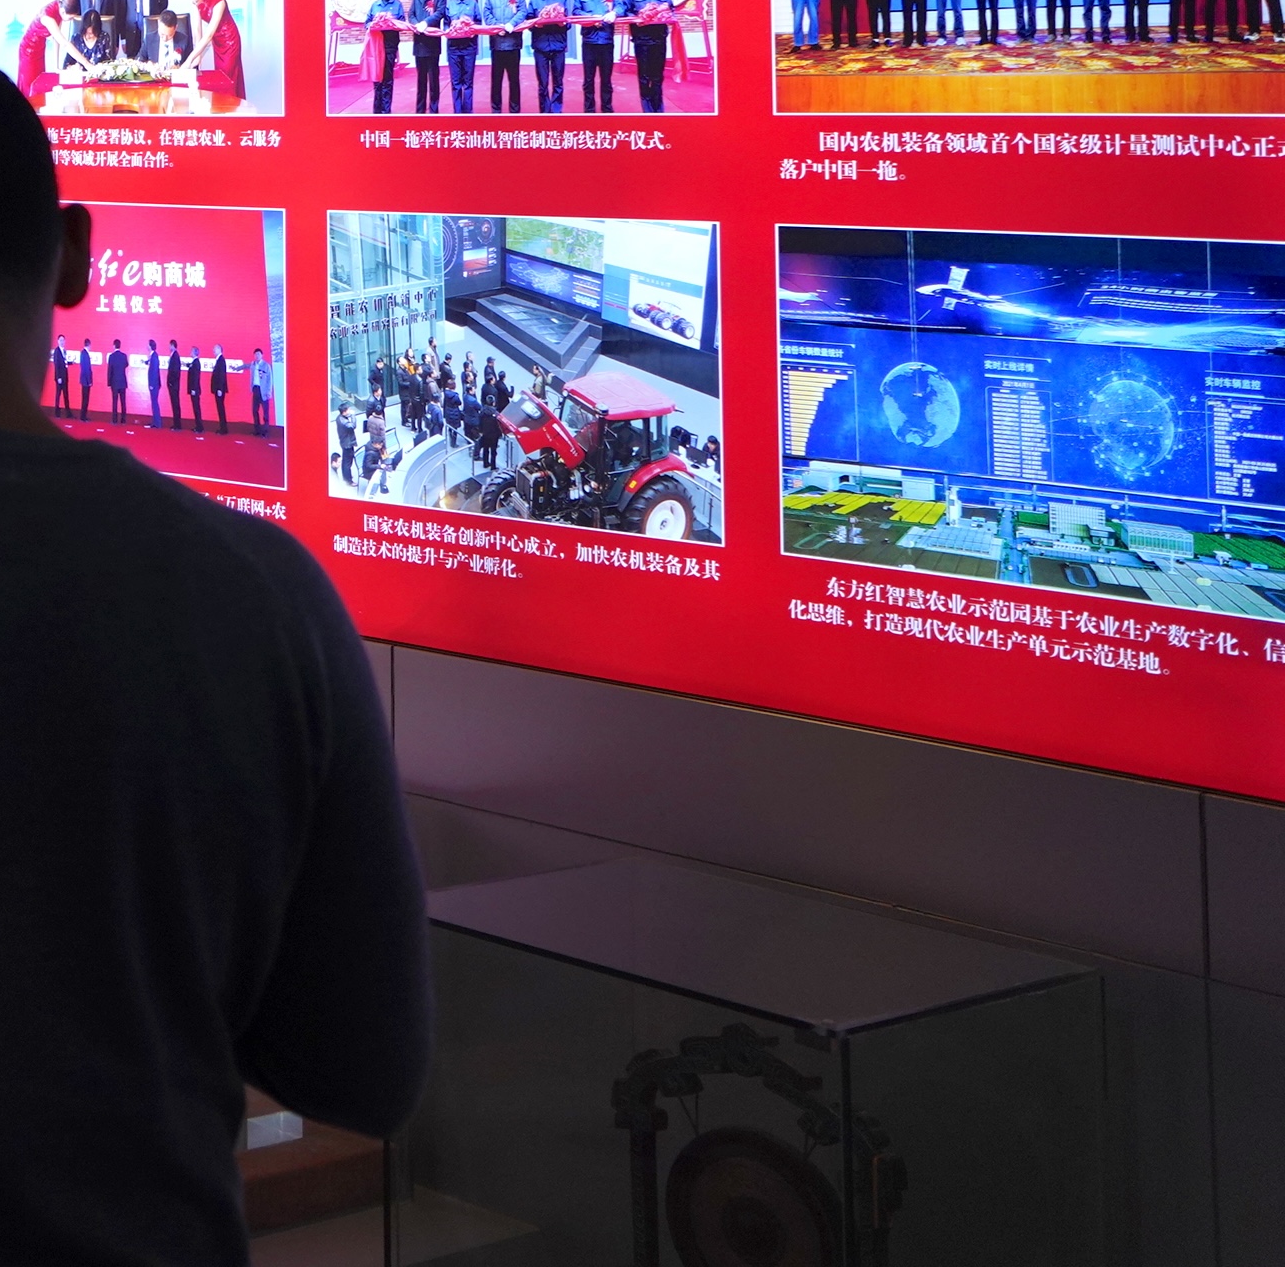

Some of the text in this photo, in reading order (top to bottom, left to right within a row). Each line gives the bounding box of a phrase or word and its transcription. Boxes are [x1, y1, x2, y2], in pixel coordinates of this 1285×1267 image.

[360, 129, 673, 152] 中国一拖举行柴油机智能制造新线投产仪式。
[779, 159, 906, 181] 落户中国一拖。
[95, 294, 163, 314] 上线仪式
[333, 535, 526, 581] 制造技术的提升与产业孵化。
[363, 514, 721, 581] 国家农机装备创新中心成立，加快农机装备及其
[788, 600, 1170, 676] 化思维，打造现代农业生产单元示范基地。
